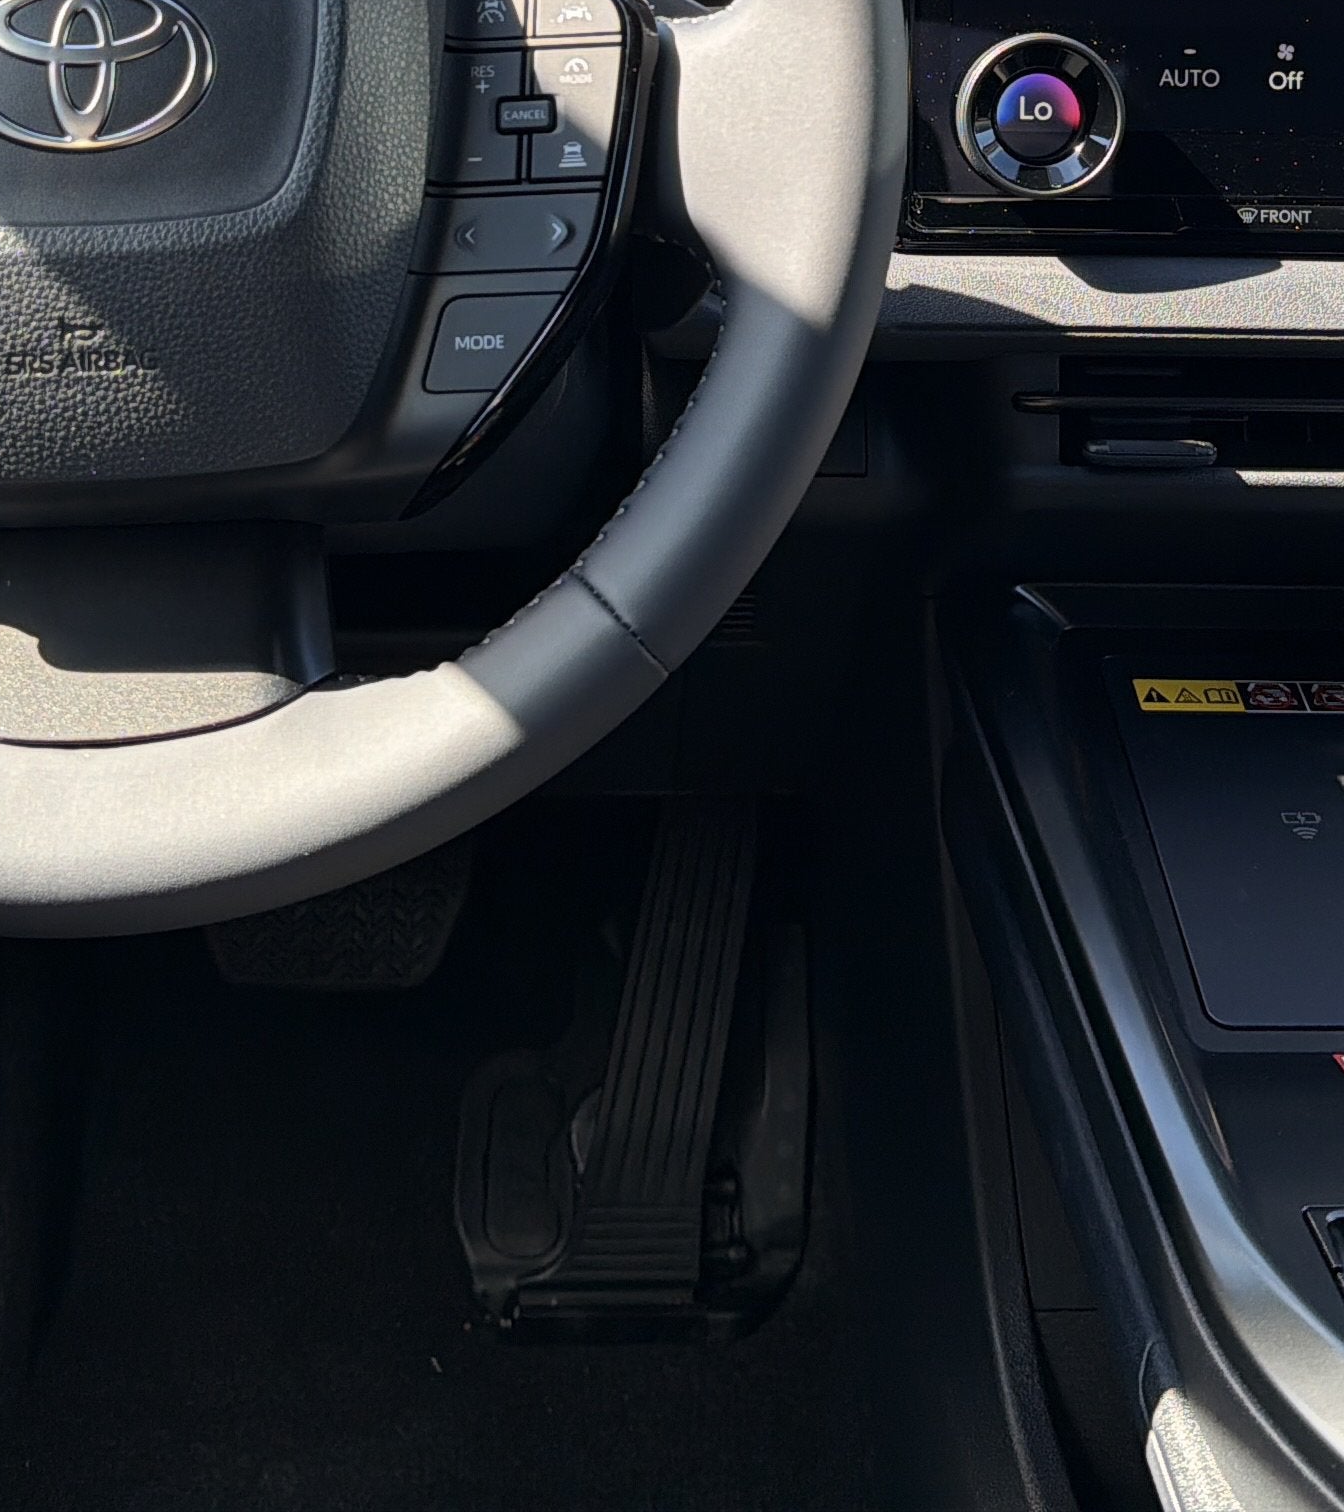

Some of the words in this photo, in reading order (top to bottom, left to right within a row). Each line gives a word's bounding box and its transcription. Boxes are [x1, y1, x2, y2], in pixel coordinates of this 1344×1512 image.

[471, 65, 495, 78] RES
[1159, 69, 1220, 87] AUTO
[1269, 71, 1304, 90] Off
[504, 109, 546, 120] CANCEL
[1019, 96, 1052, 121] Lo
[1260, 209, 1312, 224] FRONT
[454, 334, 505, 350] MODE
[6, 352, 56, 377] SRS
[59, 348, 159, 374] AIRBAG
